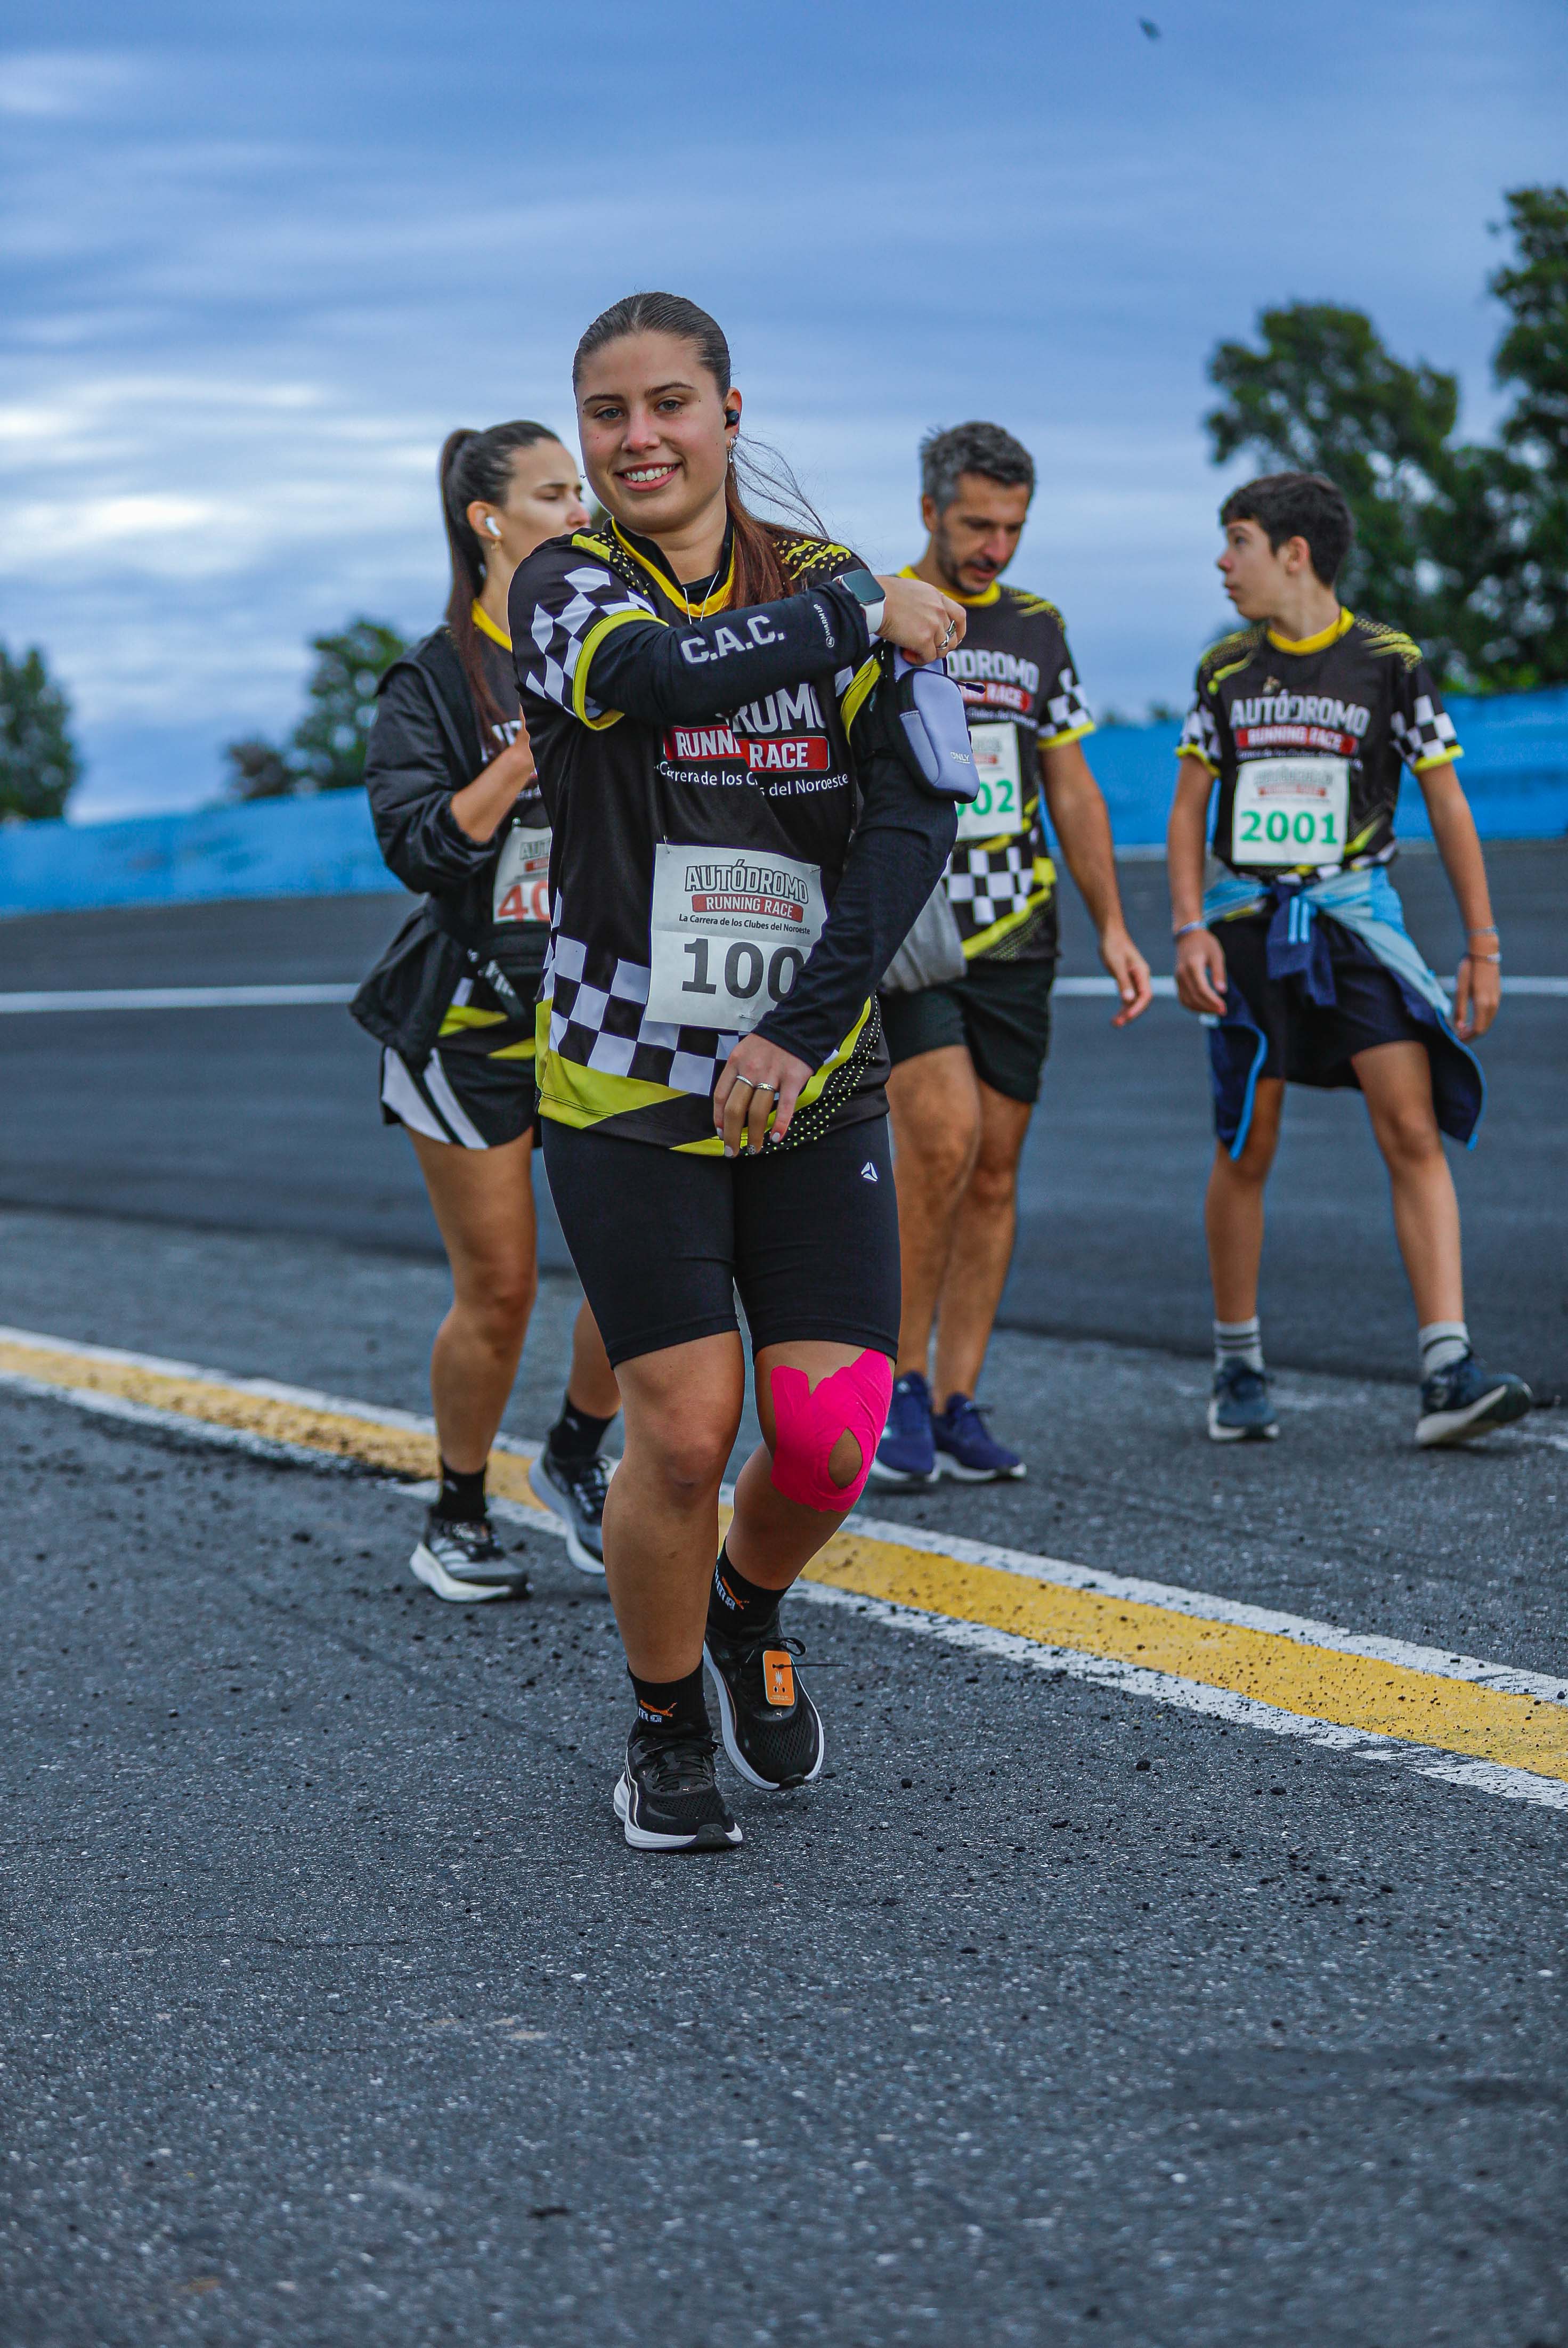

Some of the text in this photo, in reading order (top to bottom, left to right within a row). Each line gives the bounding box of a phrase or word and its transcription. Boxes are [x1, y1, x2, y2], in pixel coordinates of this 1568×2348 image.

[680, 614, 785, 663] C.A.C.
[1229, 688, 1371, 738] AUTÓDROMO
[675, 729, 808, 768] RUNN RACE
[950, 751, 970, 761] ONLY
[722, 771, 742, 785] los
[769, 781, 791, 796] del
[795, 774, 849, 794] Noroeste
[1240, 809, 1338, 844] 2001
[685, 859, 809, 904] AUTÓDROMO
[498, 880, 550, 922] 40
[706, 896, 794, 918] RUNNING RACE
[679, 913, 811, 935] La Carrera de los Clubes del Noroeste
